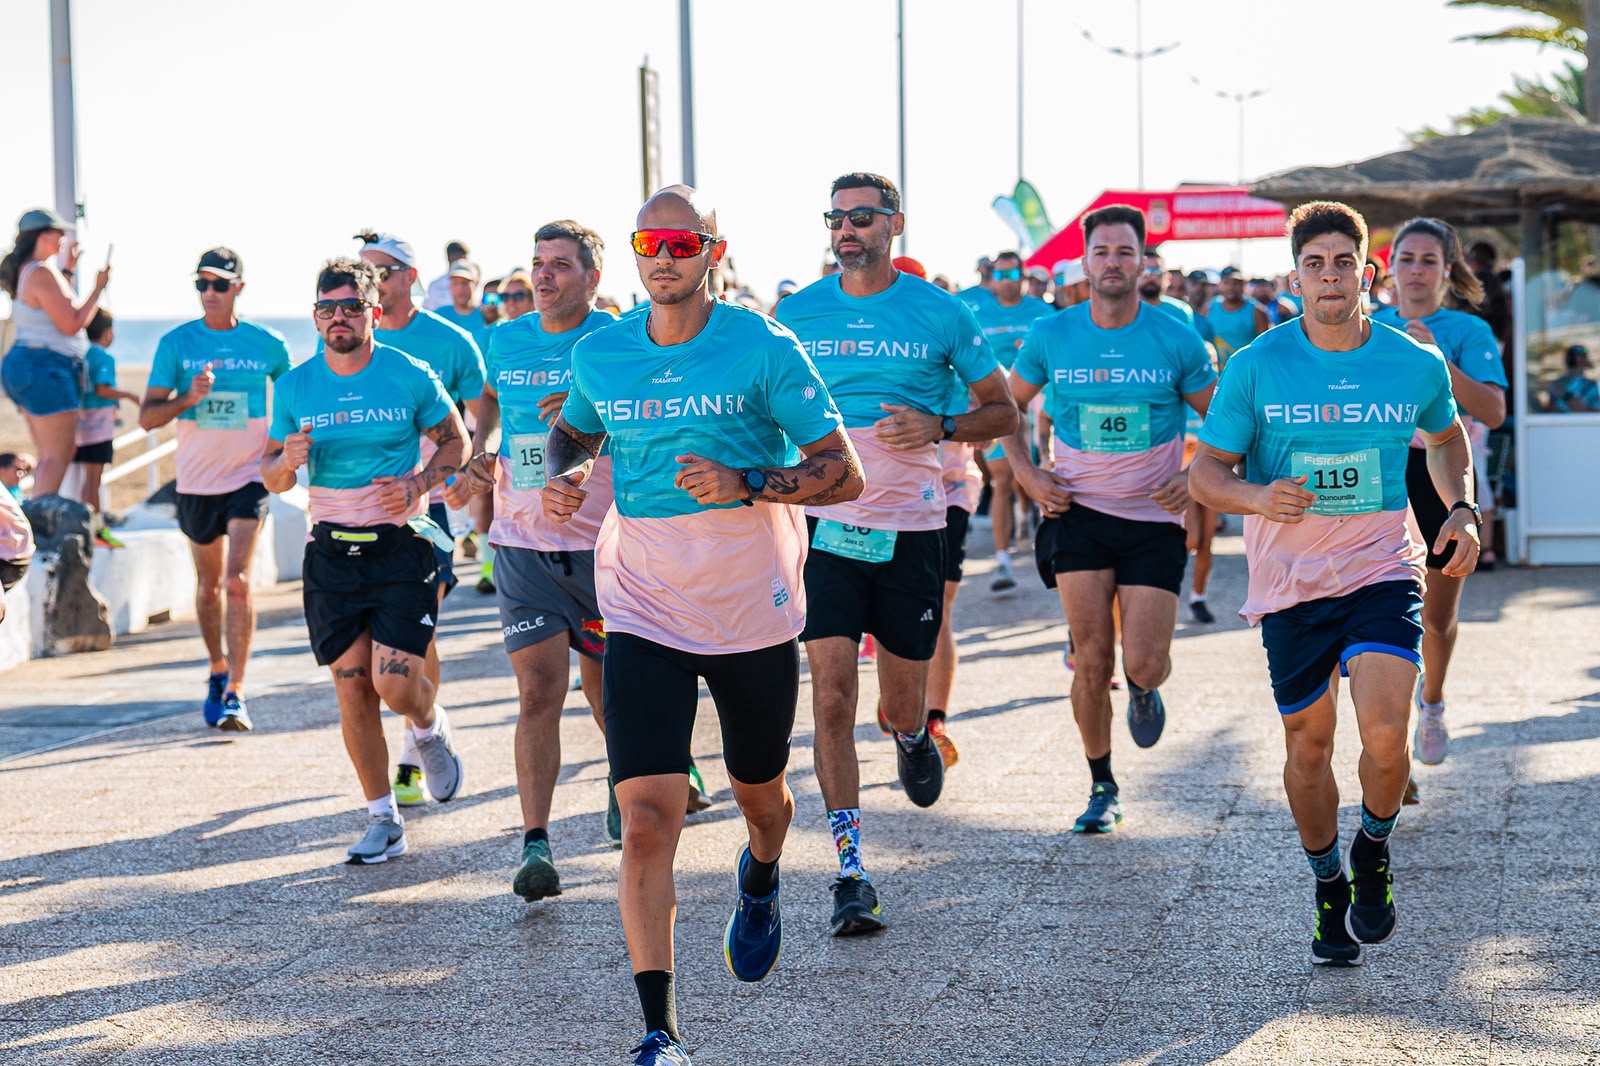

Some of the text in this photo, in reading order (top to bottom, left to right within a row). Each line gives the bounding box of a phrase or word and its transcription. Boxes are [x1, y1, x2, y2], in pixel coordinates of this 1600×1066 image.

[496, 369, 573, 386] FISIOSA
[1054, 368, 1157, 384] FISIOSAN
[206, 399, 236, 415] 172
[594, 394, 745, 421] FISIOSAN 5K
[1264, 403, 1403, 424] FISIOSAN
[300, 408, 393, 429] FISIOSAN
[1099, 416, 1128, 433] 46
[520, 447, 546, 467] 15
[1313, 467, 1359, 490] 119
[504, 616, 545, 637] RACLE
